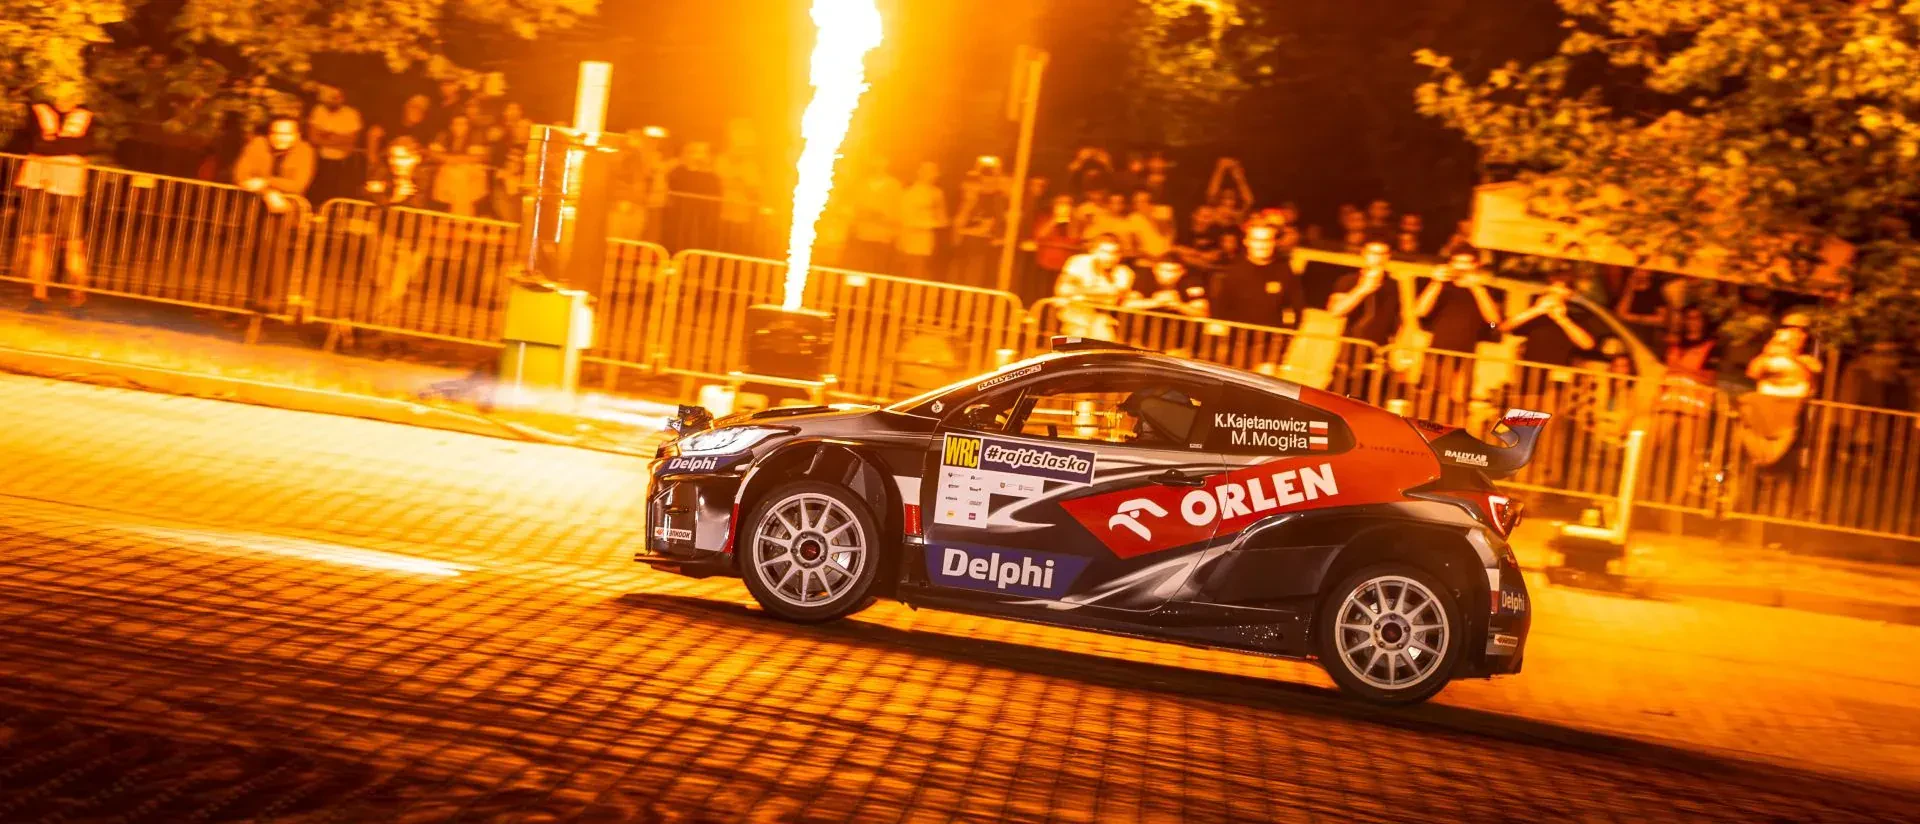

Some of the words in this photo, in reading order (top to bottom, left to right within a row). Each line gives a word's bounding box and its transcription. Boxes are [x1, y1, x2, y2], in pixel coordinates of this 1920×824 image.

[979, 369, 1030, 388] RALLYSHOP
[1215, 413, 1308, 432] K.Kajetanowicz
[945, 436, 981, 468] WRC
[1231, 431, 1308, 451] M.Mogiła
[668, 457, 718, 472] Delphi
[986, 446, 1089, 472] #rajdslaska
[1444, 450, 1487, 462] RALLYLAB
[1180, 462, 1339, 527] ORLEN
[942, 548, 1055, 589] Delphi
[1502, 590, 1525, 614] Delphi
